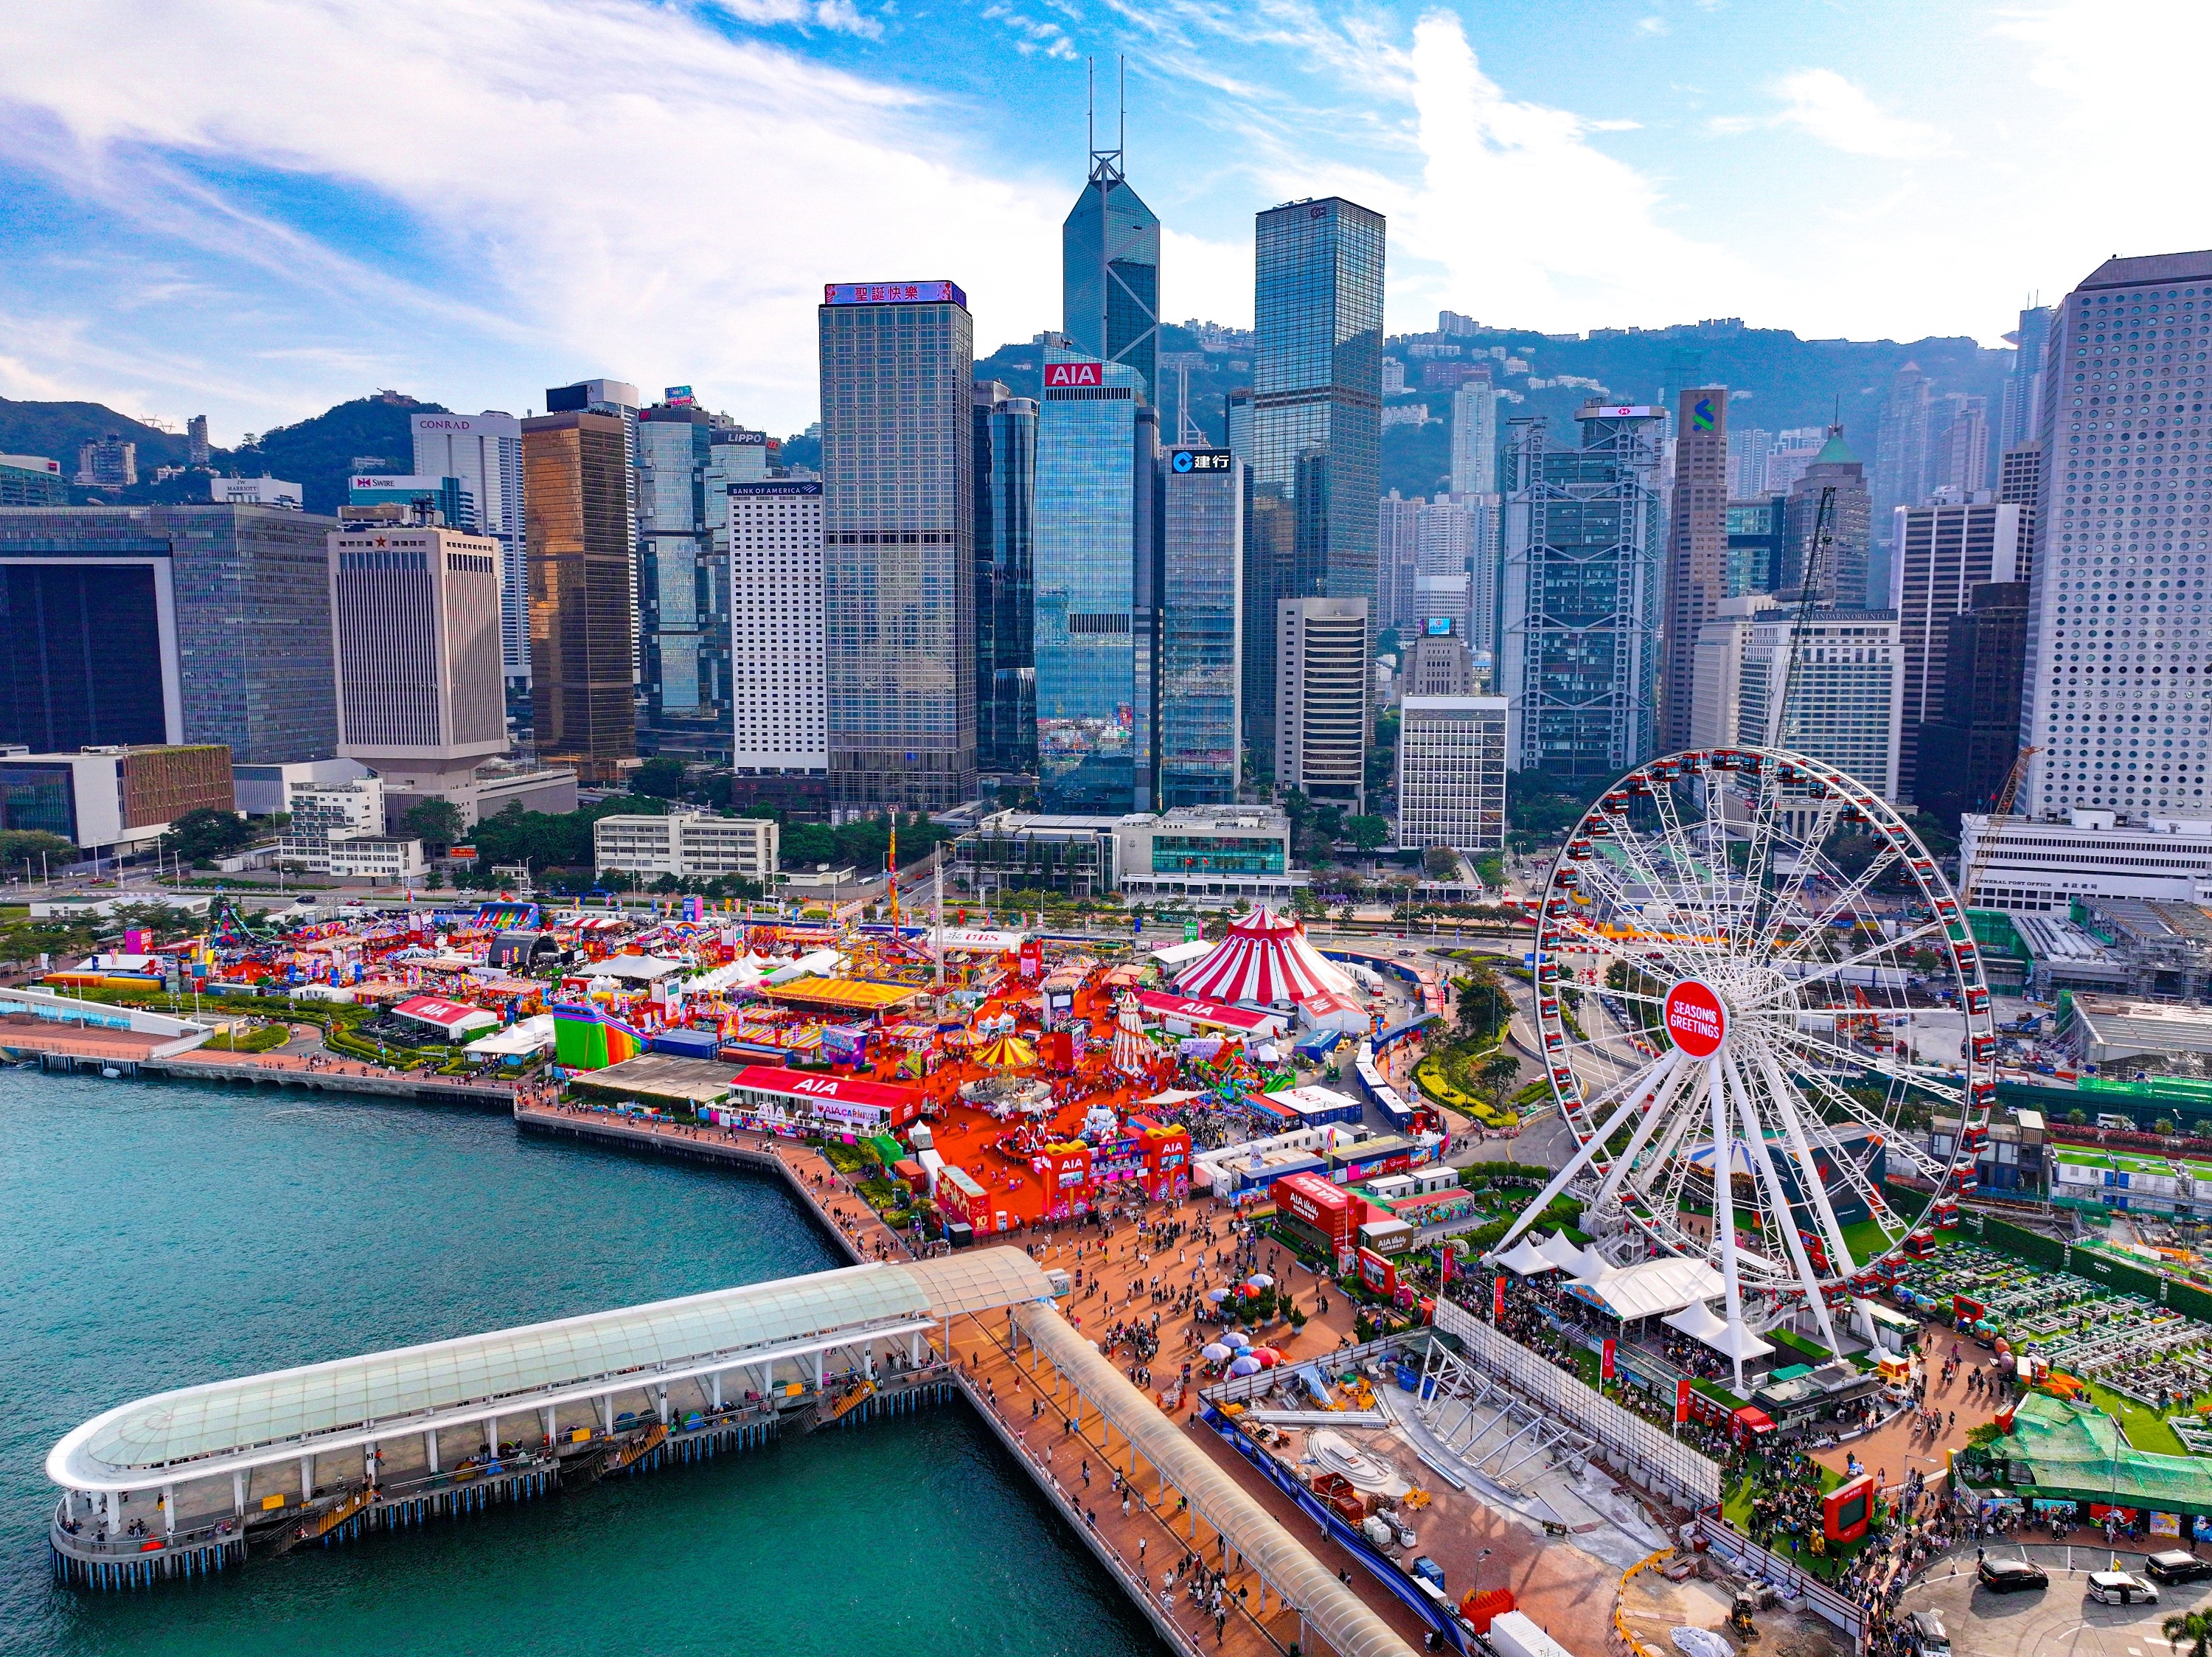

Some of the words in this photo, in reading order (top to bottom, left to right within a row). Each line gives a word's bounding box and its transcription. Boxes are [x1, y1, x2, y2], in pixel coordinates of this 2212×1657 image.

[855, 286, 919, 302] 聖誕快樂
[1051, 366, 1096, 384] AIA
[420, 420, 470, 429] CONRAD
[728, 434, 762, 442] LIPPO
[1194, 455, 1230, 469] 建行
[417, 1004, 449, 1018] AIA
[1178, 1002, 1214, 1016] AIA
[1309, 998, 1332, 1012] AIA
[1671, 1014, 1719, 1039] GREETINGS
[792, 1078, 838, 1095] AIA
[757, 1102, 787, 1123] AIA
[1099, 1142, 1138, 1156] CARNIVAL
[1162, 1142, 1183, 1154] AIA
[1062, 1158, 1083, 1171] AIA
[1290, 1192, 1304, 1208] AIA
[1304, 1200, 1319, 1219] Vitality
[1377, 1238, 1391, 1248] AIA
[1391, 1235, 1407, 1245] Vitality
